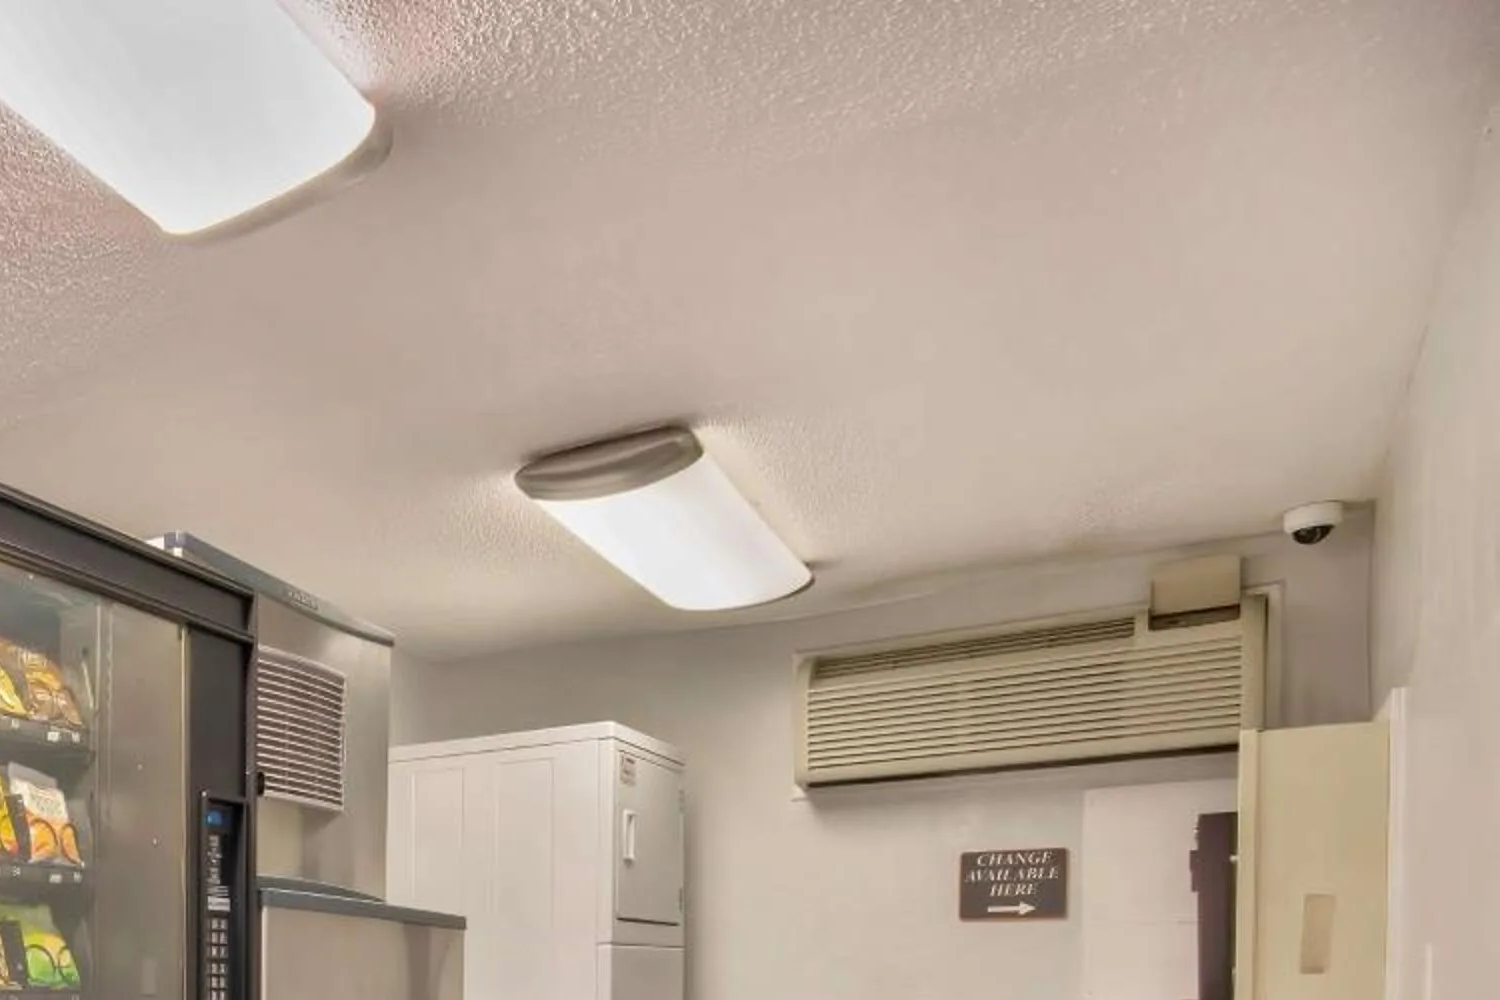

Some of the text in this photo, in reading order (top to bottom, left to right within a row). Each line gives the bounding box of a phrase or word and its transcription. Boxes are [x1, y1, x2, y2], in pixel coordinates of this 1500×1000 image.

[976, 850, 1053, 867] CHANGE
[963, 867, 1059, 883] AVAILABLE
[989, 882, 1037, 897] HERE
